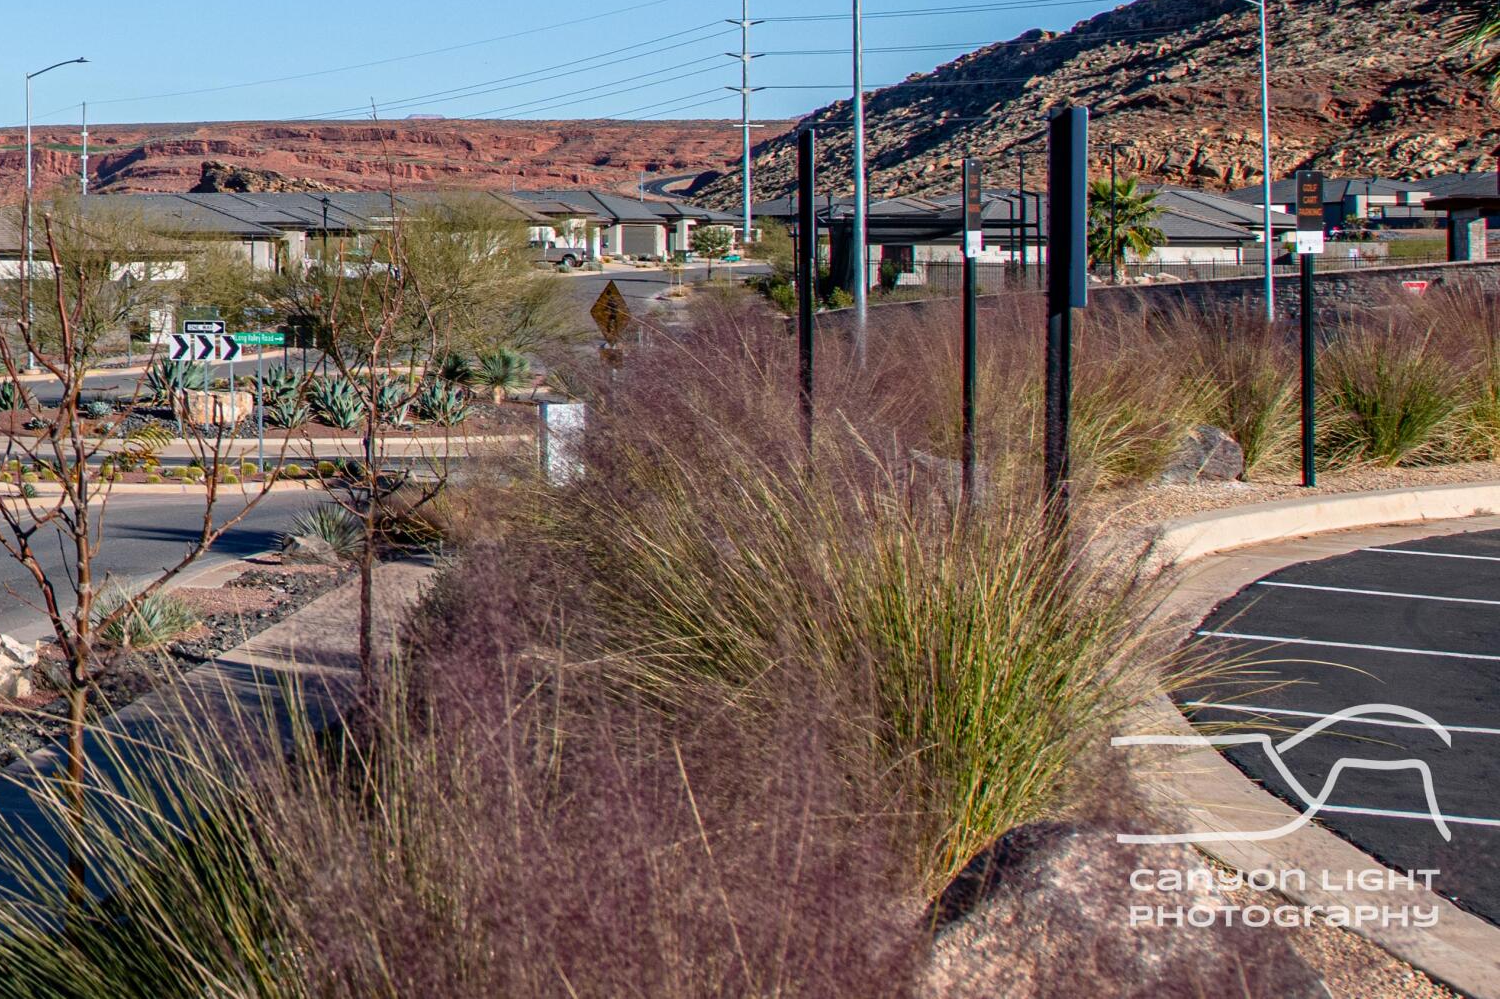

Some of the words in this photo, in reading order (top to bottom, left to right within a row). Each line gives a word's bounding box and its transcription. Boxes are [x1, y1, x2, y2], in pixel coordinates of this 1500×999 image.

[235, 334, 247, 343] Long
[248, 333, 261, 344] Valley
[261, 334, 274, 342] Road
